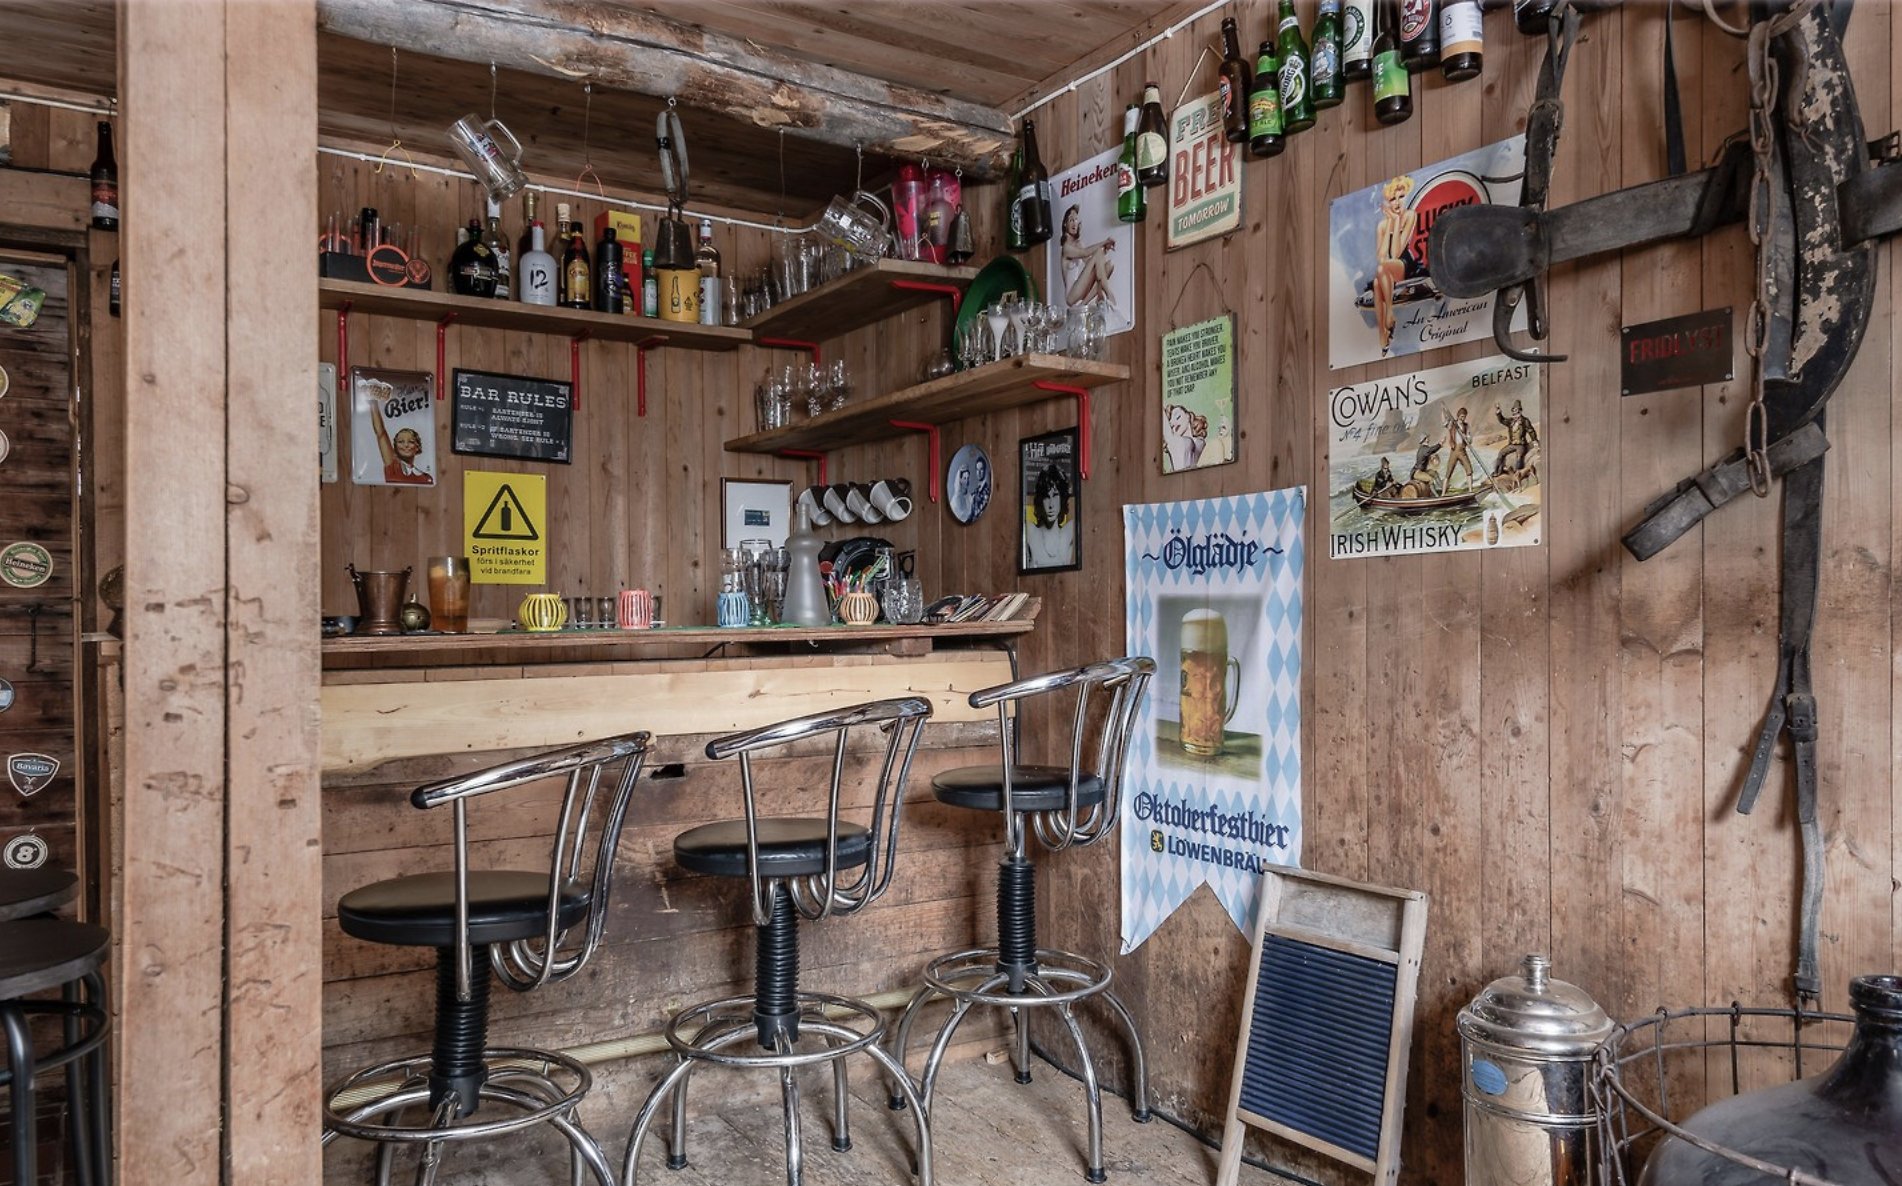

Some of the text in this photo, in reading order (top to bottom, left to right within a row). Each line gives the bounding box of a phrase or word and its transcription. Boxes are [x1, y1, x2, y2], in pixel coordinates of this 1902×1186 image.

[1176, 101, 1223, 143] FRE
[1061, 161, 1118, 198] Heineken
[1174, 130, 1236, 208] BEER
[1178, 199, 1230, 232] TOMORROW
[530, 269, 549, 289] 12
[1403, 300, 1489, 329] An American
[1177, 333, 1190, 344] MAKES
[1419, 321, 1468, 343] Original
[1472, 364, 1531, 388] BELFAST
[385, 390, 429, 418] Bier!
[460, 385, 567, 408] BAR RULES
[1332, 374, 1428, 428] COWAN'S
[1362, 422, 1390, 443] fine
[472, 544, 540, 556] Spritflaskor
[1163, 528, 1259, 575] Ölglädje
[1331, 524, 1463, 558] IRISH WHISKY
[5, 557, 46, 573] Heineken
[499, 558, 535, 566] säkerhet
[16, 762, 50, 772] Bavaria
[1134, 791, 1290, 850] Oktoberfestbier
